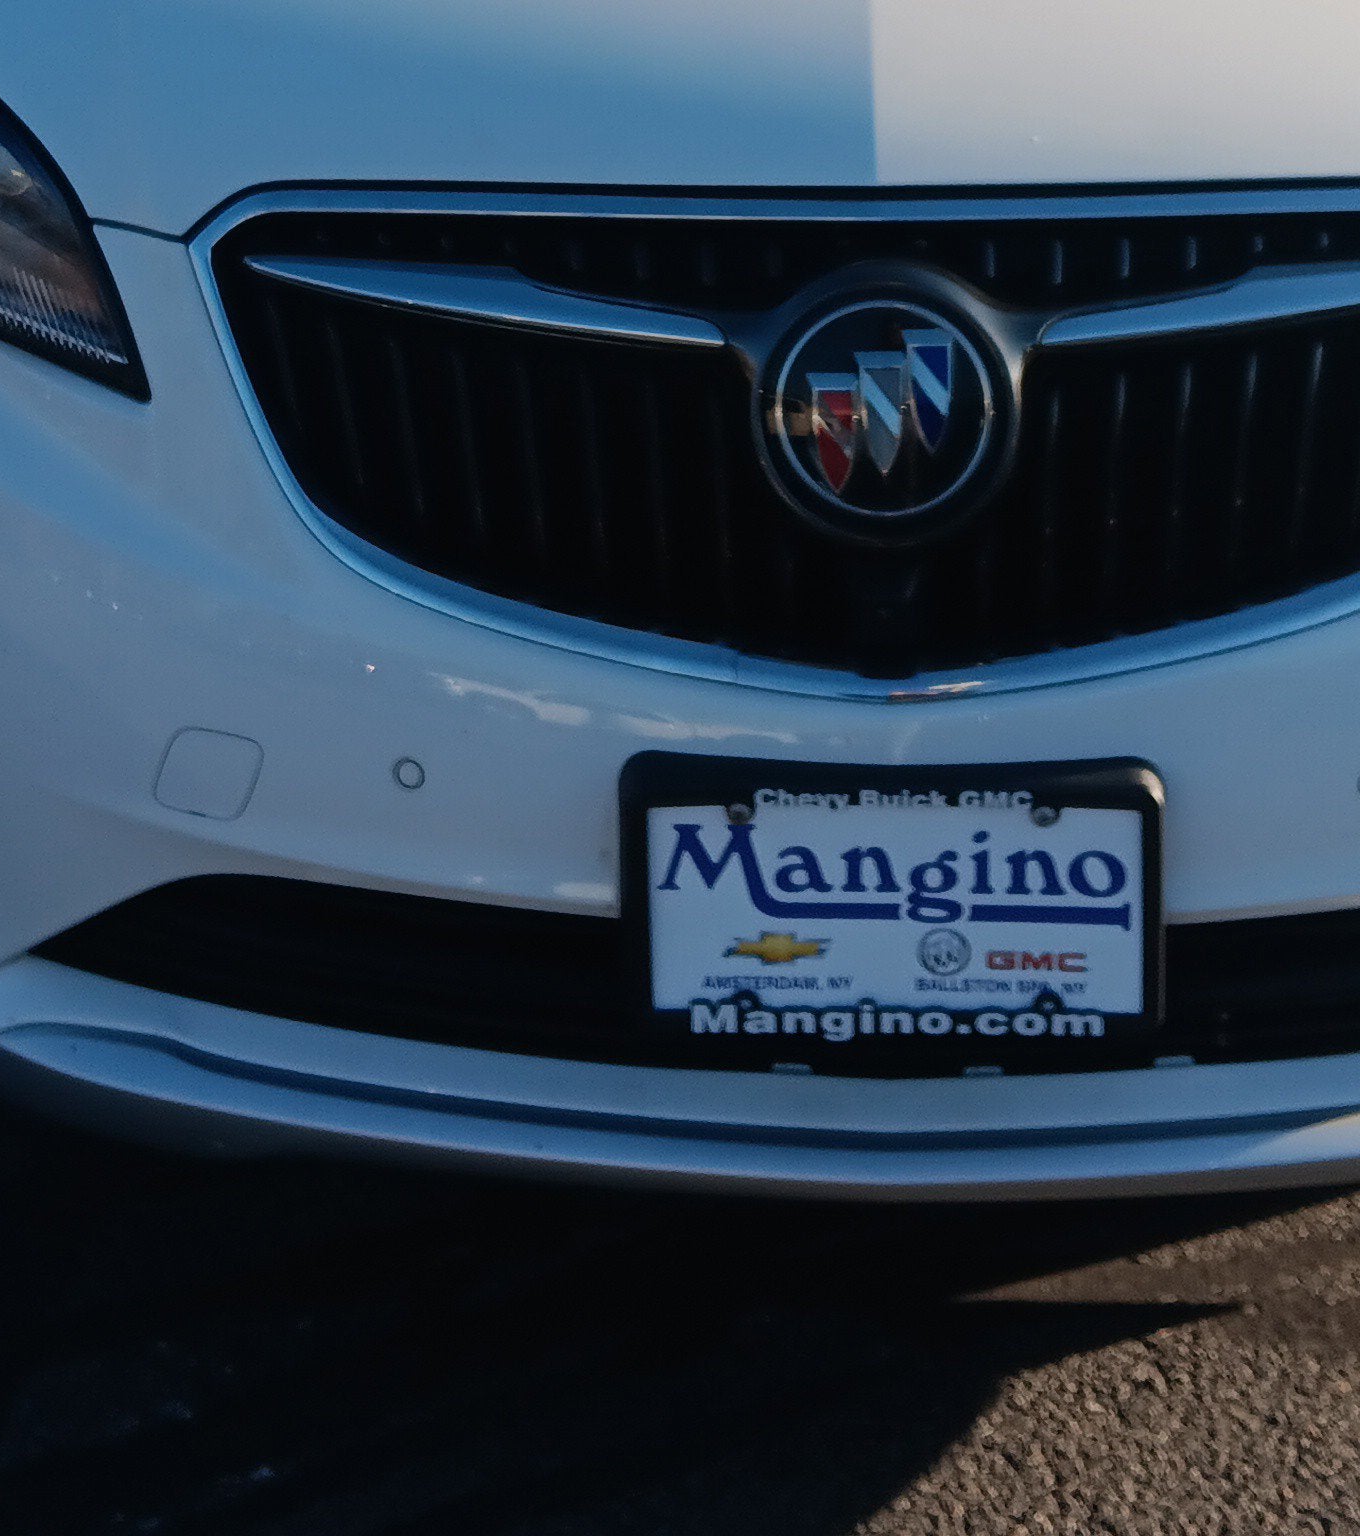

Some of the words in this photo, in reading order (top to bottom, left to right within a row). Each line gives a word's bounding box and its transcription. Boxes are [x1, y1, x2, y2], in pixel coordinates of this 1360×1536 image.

[754, 788, 850, 810] Chevy
[858, 789, 948, 809] Buick
[958, 790, 1033, 810] GMC
[657, 823, 1128, 925] Mangino
[985, 951, 1088, 972] GMC
[690, 999, 1106, 1042] Mangino.com
